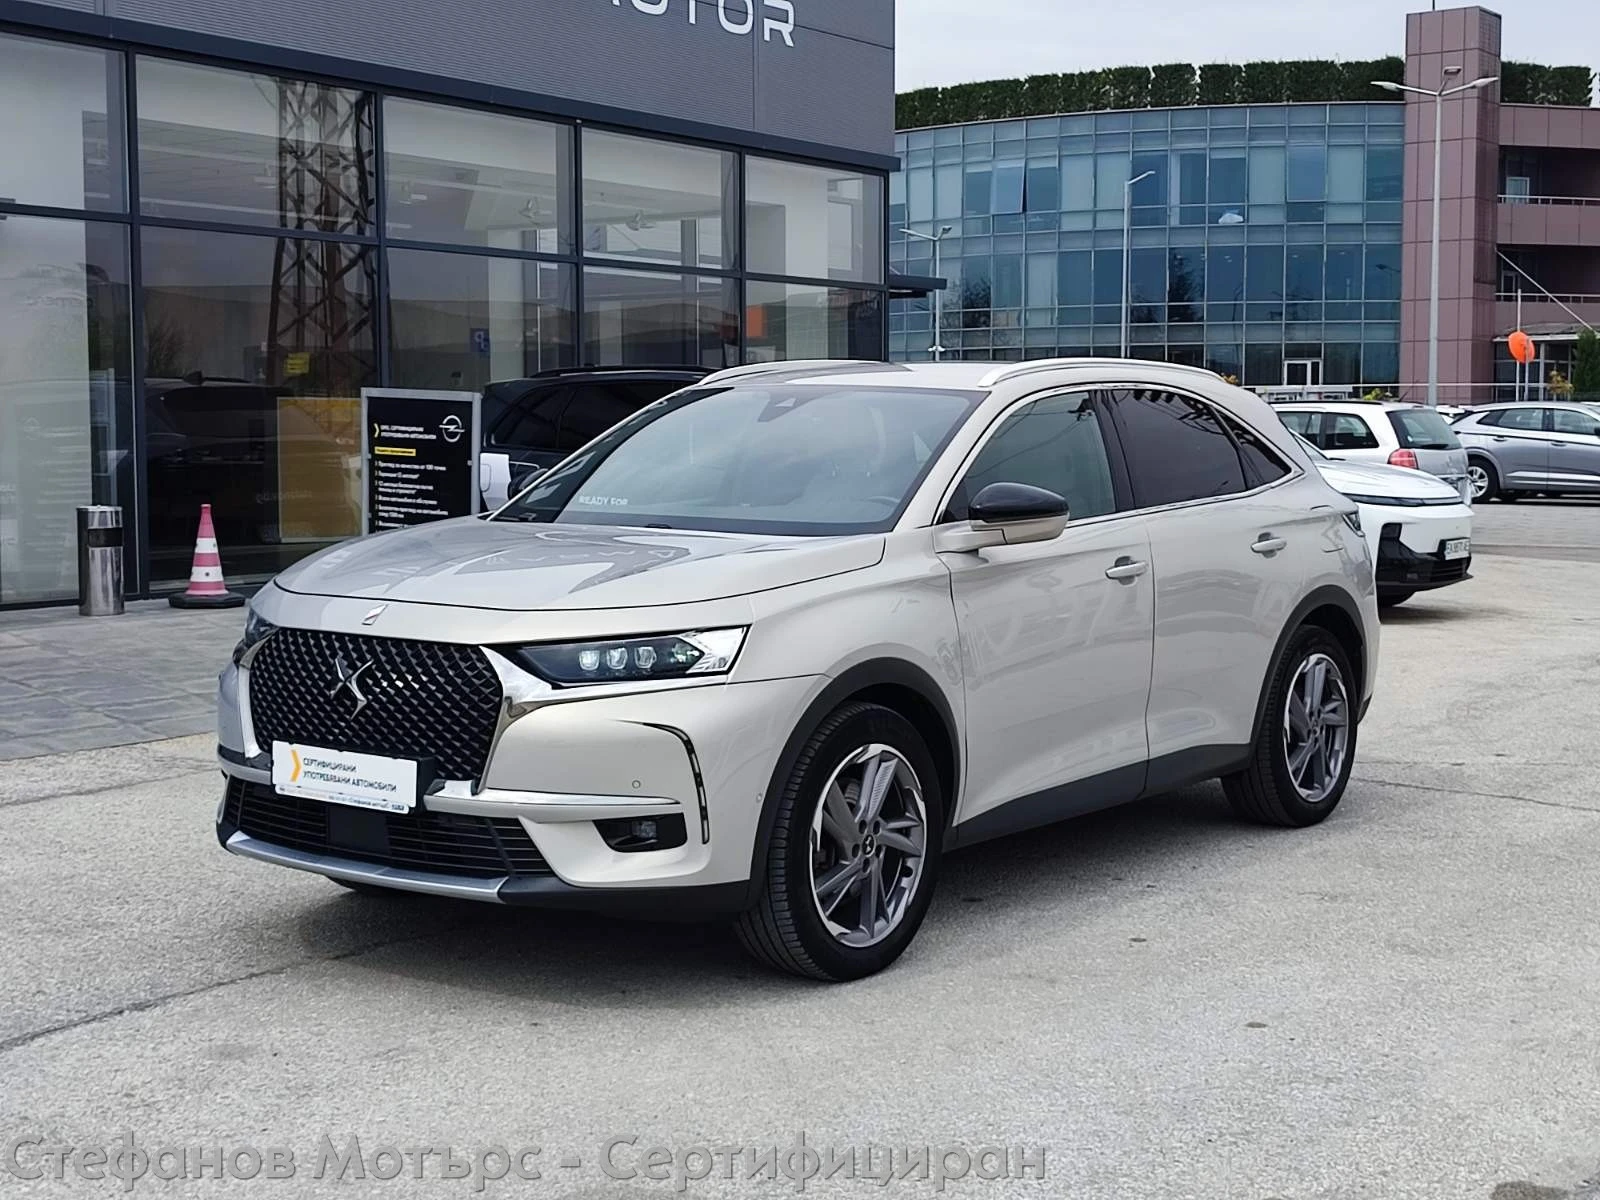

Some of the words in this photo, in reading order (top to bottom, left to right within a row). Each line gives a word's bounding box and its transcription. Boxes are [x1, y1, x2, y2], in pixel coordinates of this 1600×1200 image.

[303, 757, 357, 773] СЕРТИФИЦИРАНИ
[303, 770, 351, 786] УПОТРЕБЯВАНИ
[351, 777, 397, 793] АВТОМОБИЛИ
